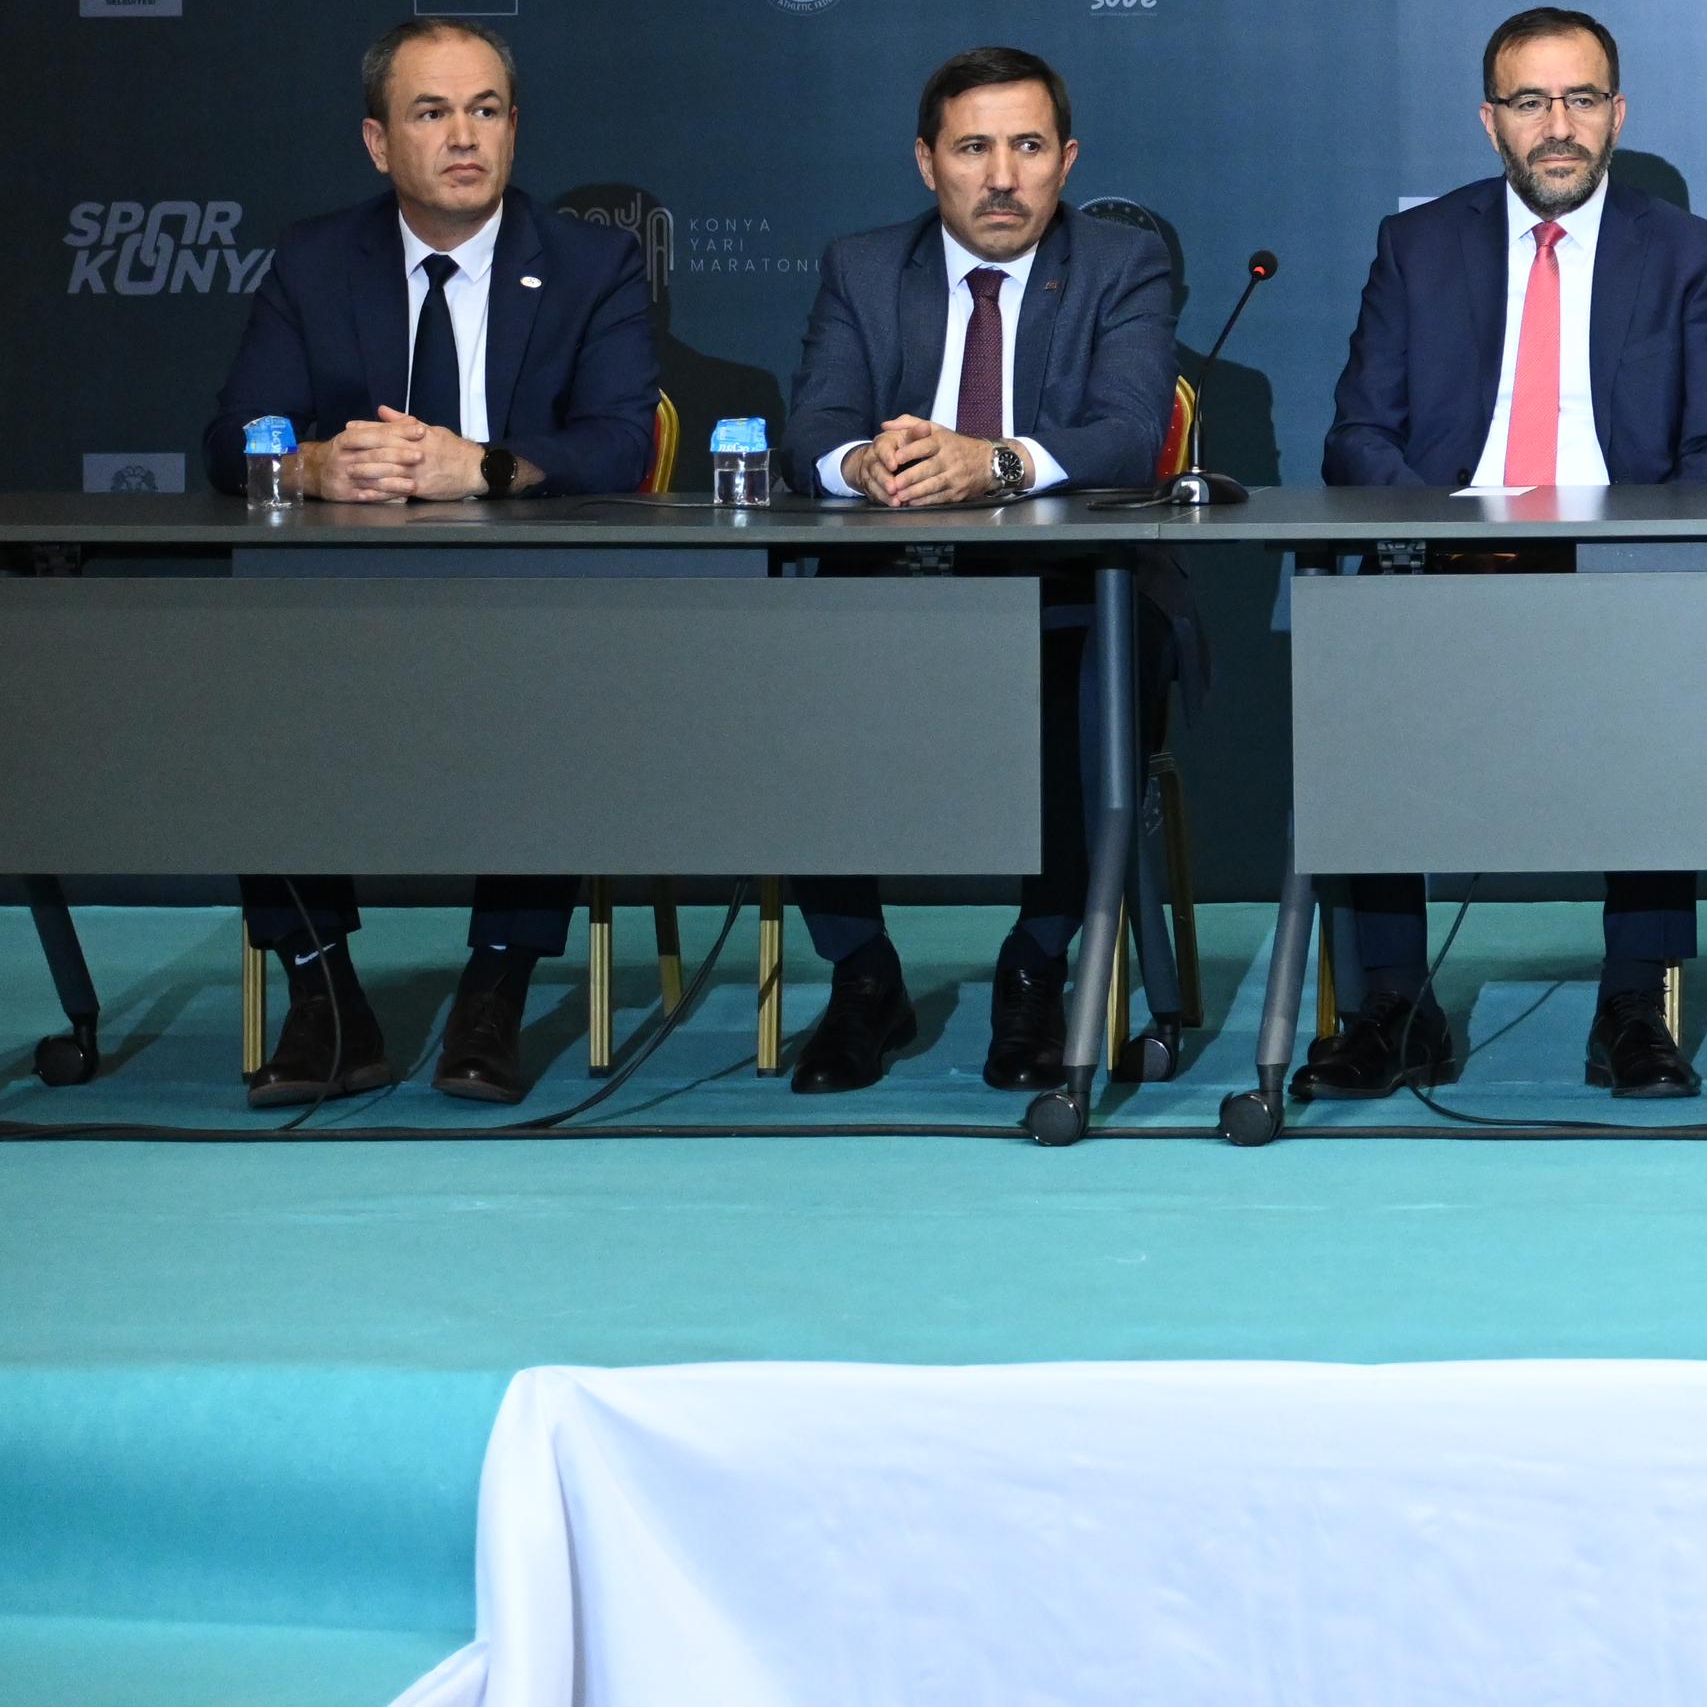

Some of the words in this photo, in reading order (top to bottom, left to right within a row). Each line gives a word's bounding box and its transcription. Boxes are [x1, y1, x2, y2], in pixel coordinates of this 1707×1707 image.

[64, 201, 241, 249] SPOR
[690, 219, 770, 232] KONYA
[690, 239, 743, 252] YARI
